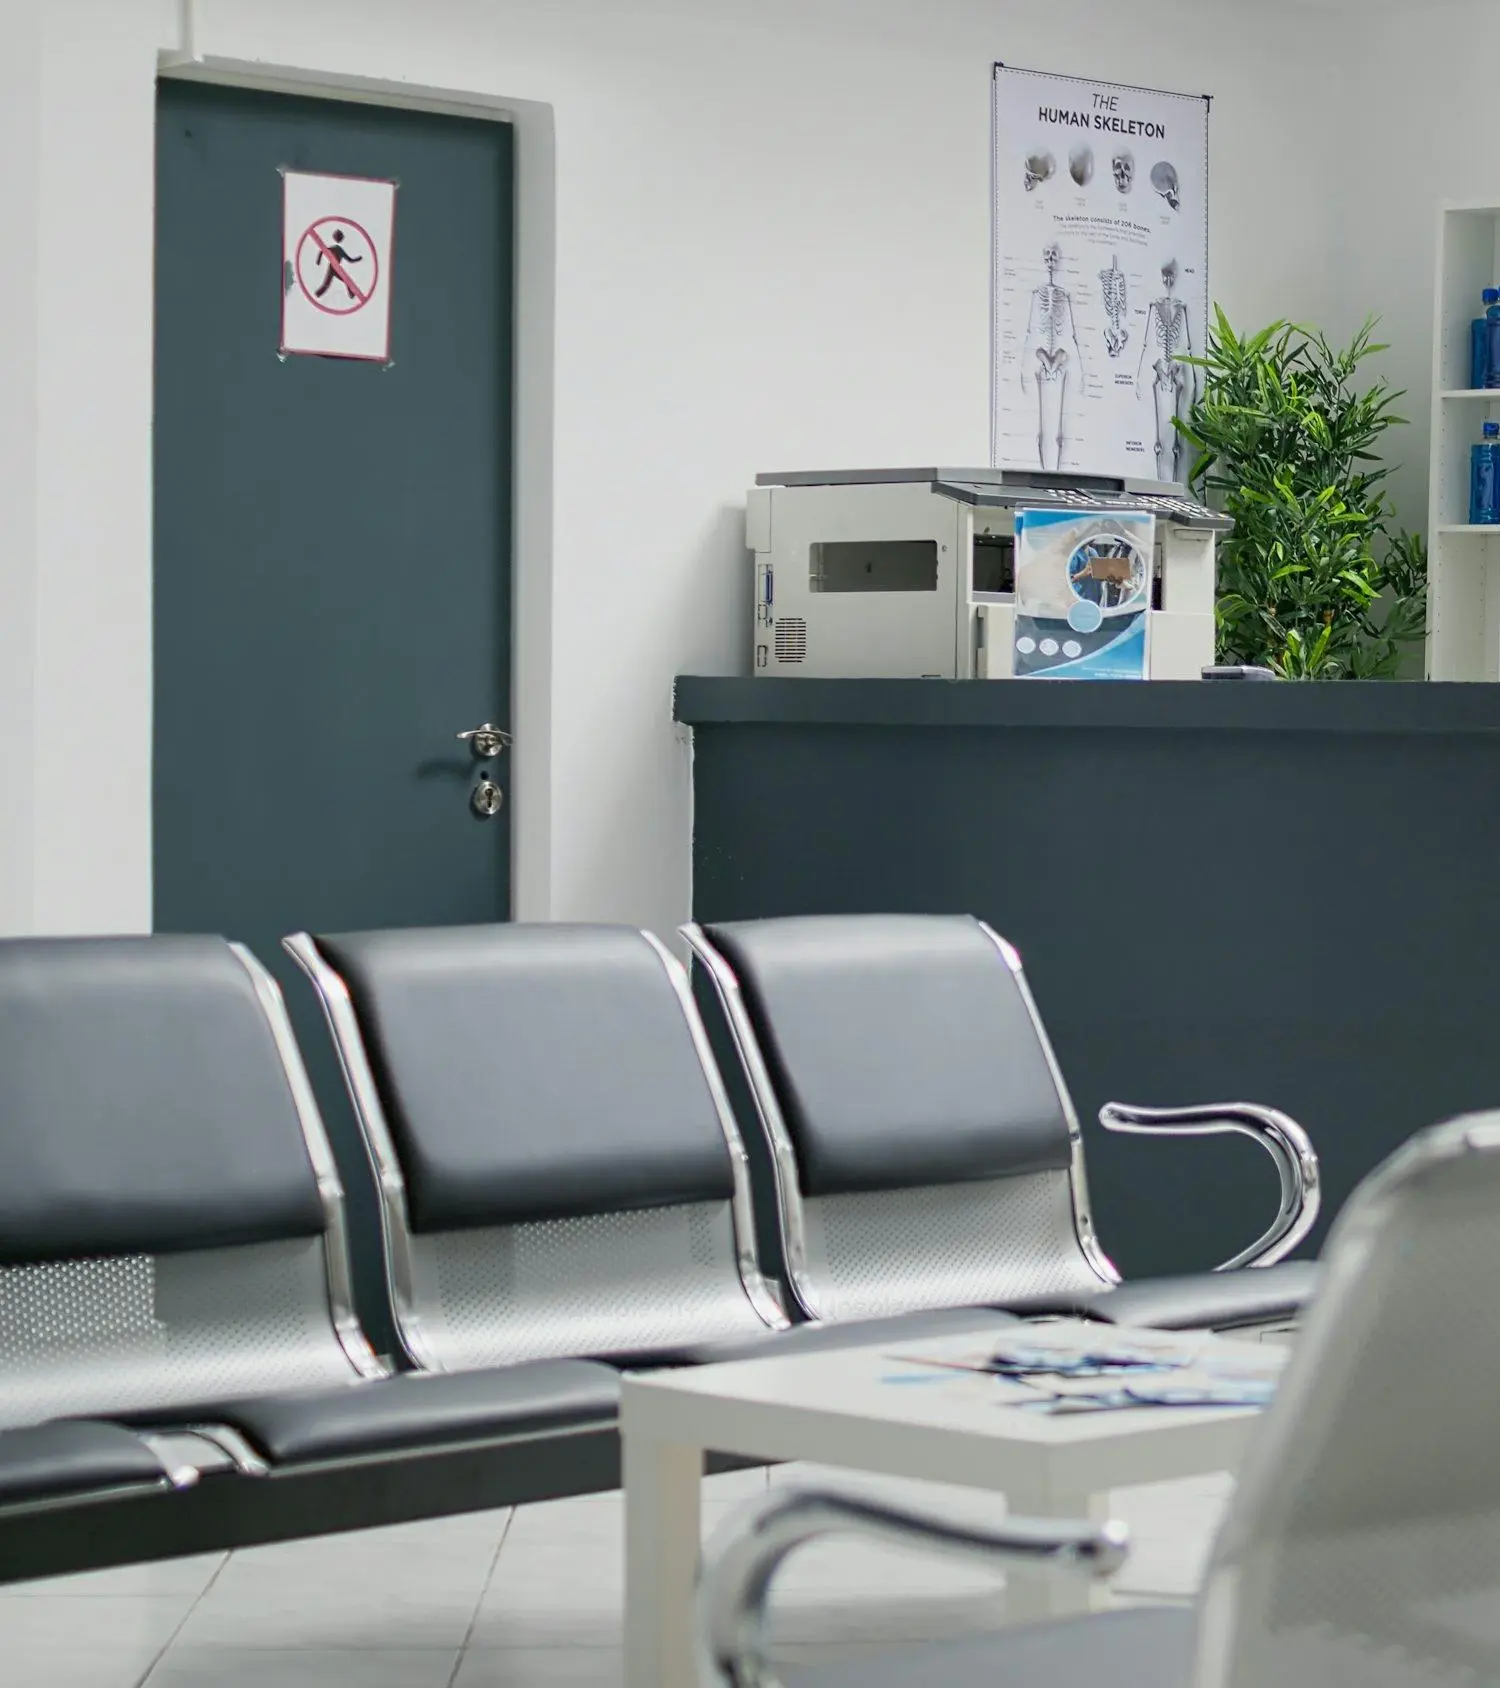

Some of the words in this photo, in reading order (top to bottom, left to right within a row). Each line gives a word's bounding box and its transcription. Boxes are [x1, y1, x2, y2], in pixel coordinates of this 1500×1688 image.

[1092, 93, 1119, 111] THE
[1038, 106, 1090, 128] HUMAN
[1094, 114, 1165, 139] SKELETON
[1090, 216, 1112, 224] consists
[1121, 220, 1132, 228] 206
